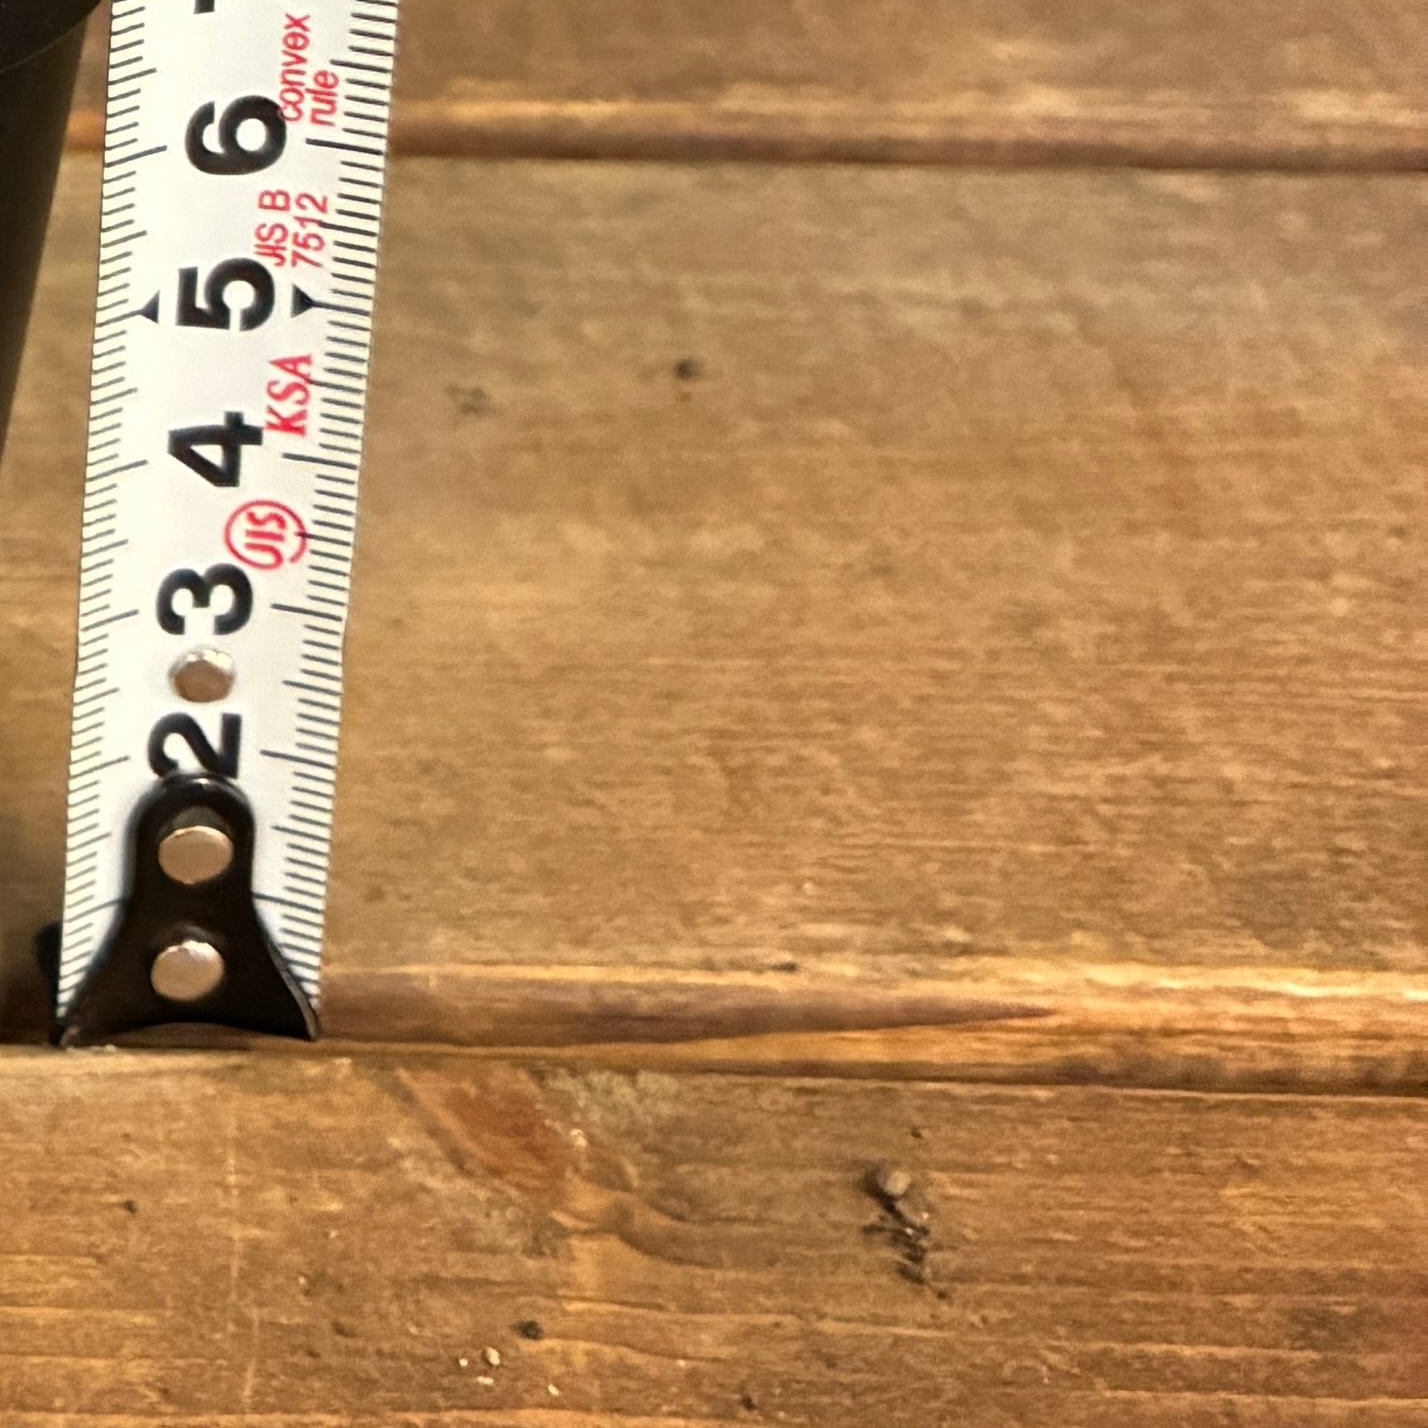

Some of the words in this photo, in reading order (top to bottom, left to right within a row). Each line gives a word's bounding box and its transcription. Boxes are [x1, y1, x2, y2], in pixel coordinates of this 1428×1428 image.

[278, 13, 311, 122] convex
[305, 70, 340, 127] rule
[184, 95, 287, 176] 6
[258, 189, 291, 211] B
[291, 192, 329, 268] 7512
[254, 223, 289, 267] JIS
[176, 257, 275, 331] 5
[265, 355, 313, 436] KSA
[168, 411, 263, 488] 4
[156, 562, 254, 636] 3
[148, 712, 242, 781] 2
